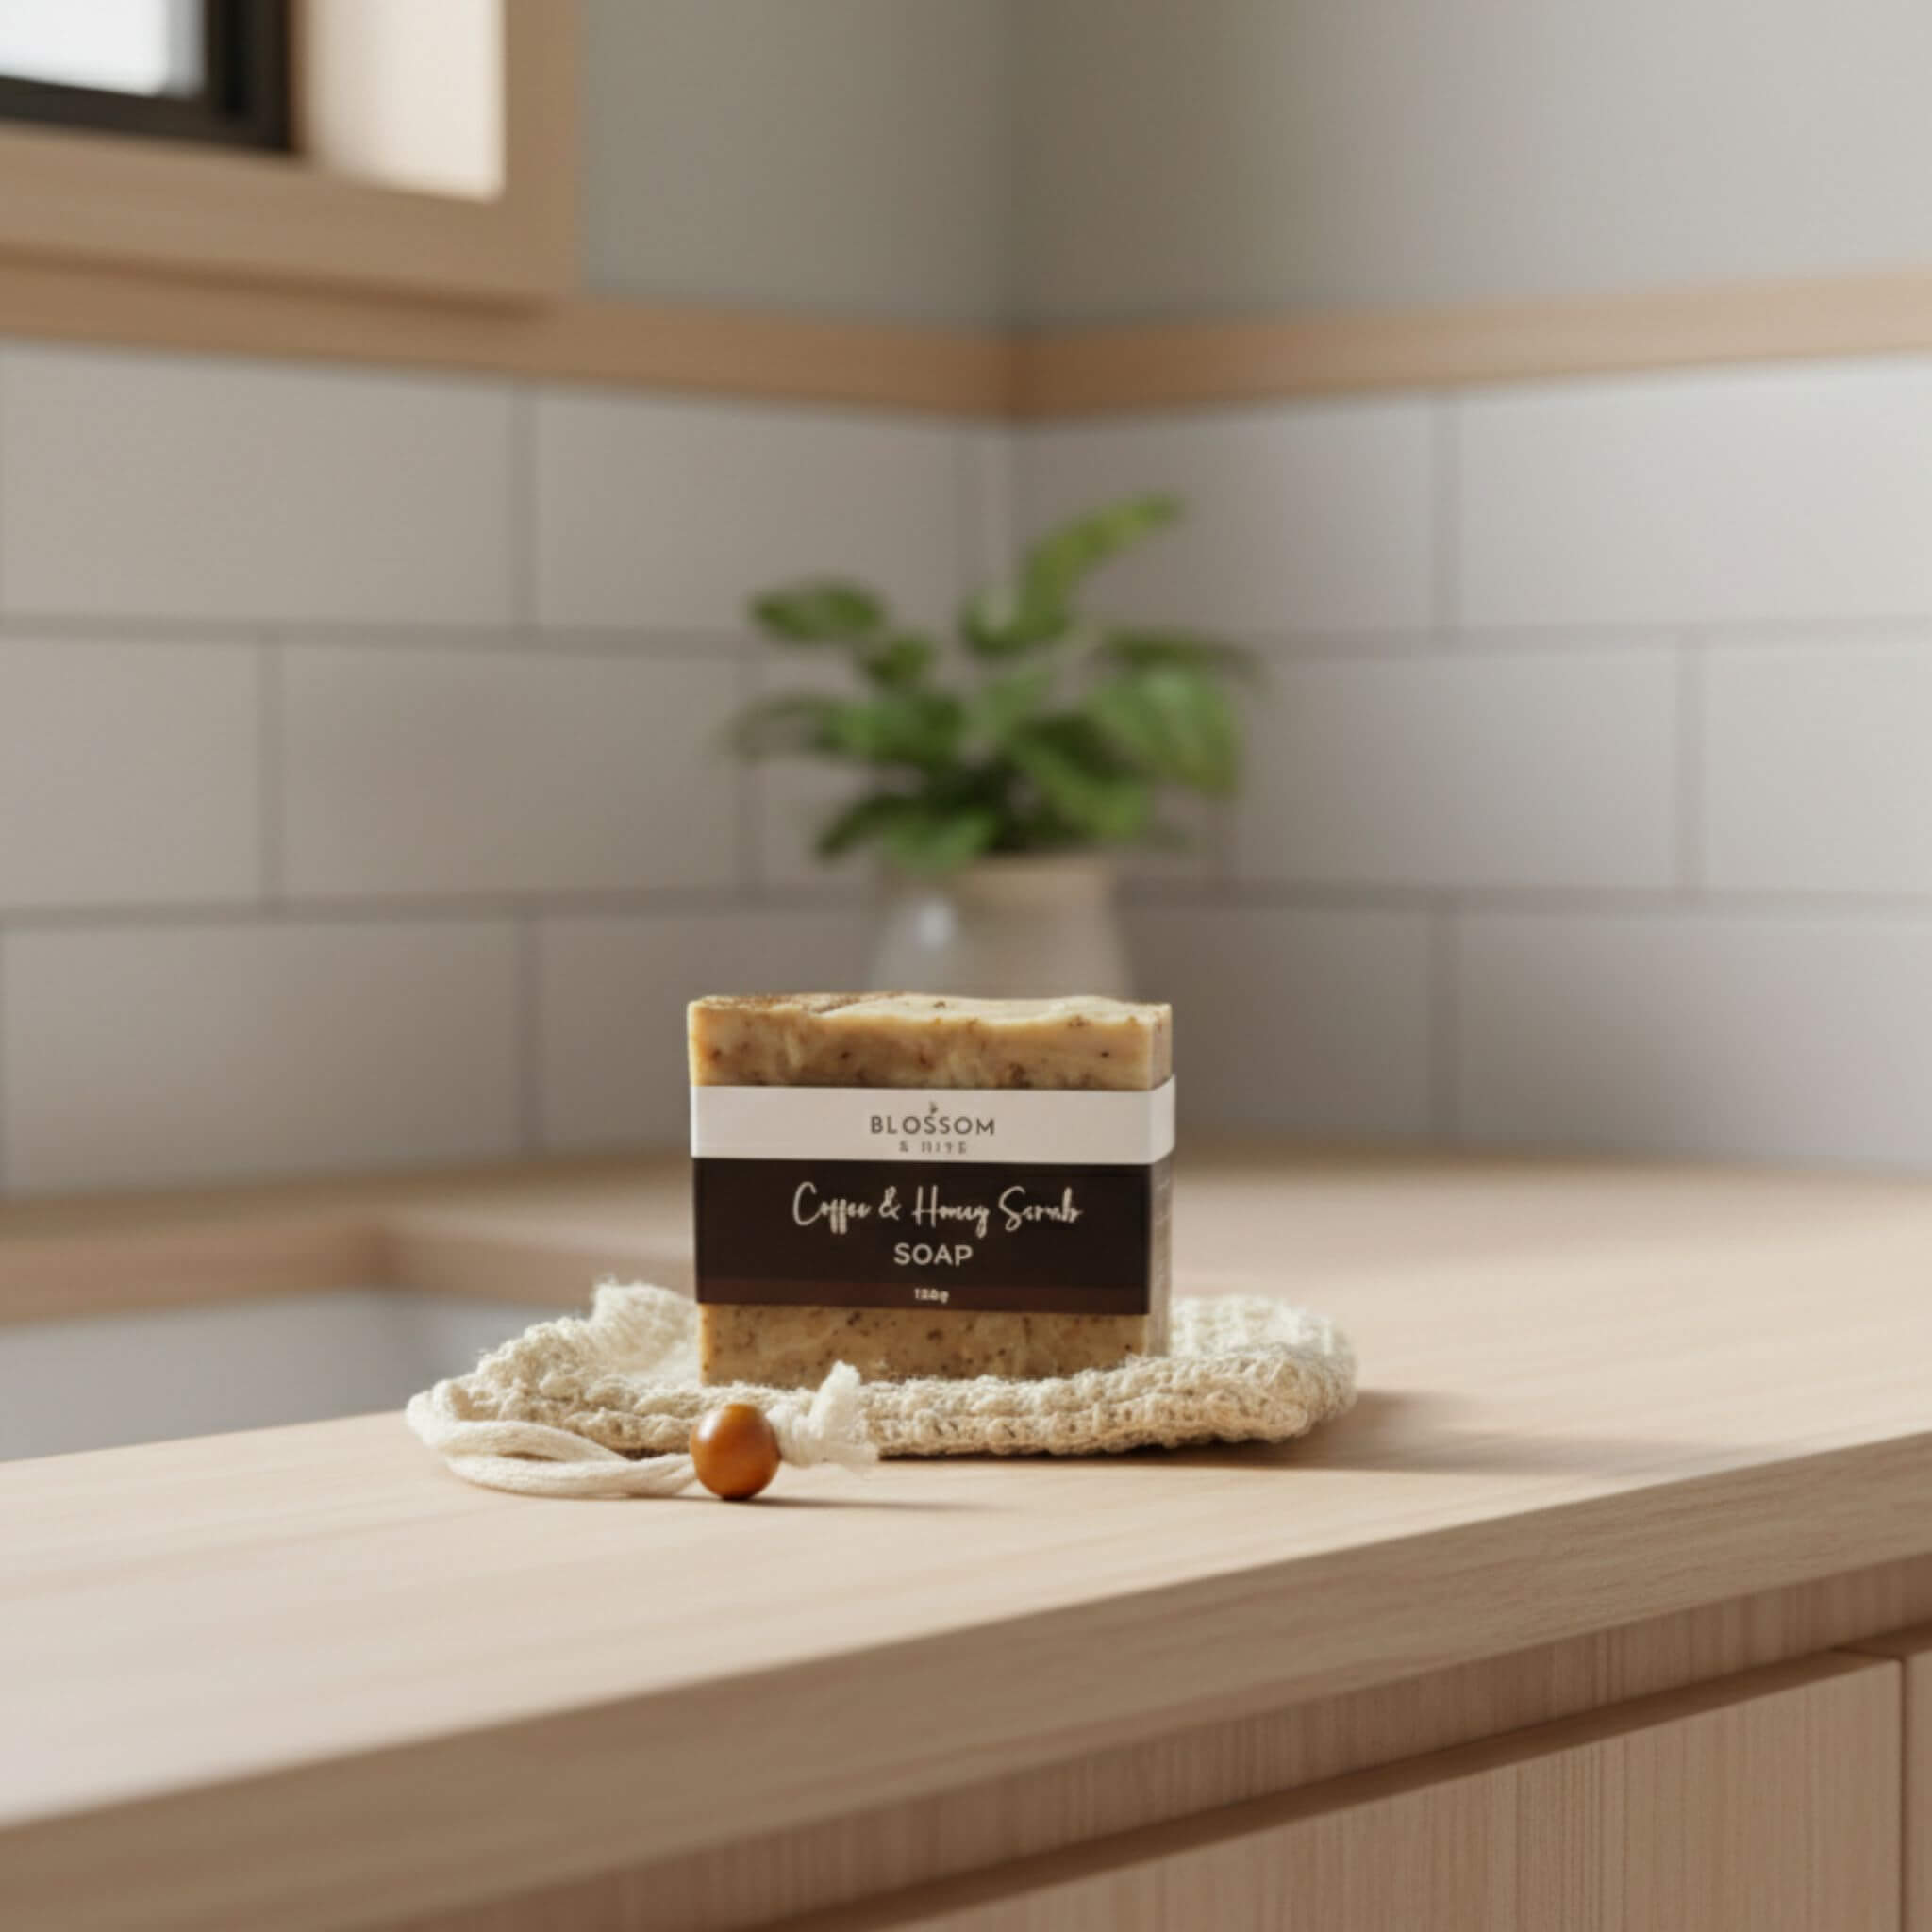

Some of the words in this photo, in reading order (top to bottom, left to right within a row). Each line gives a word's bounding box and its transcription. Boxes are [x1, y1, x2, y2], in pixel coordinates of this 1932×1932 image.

[870, 1116, 996, 1136] BLOSSOM
[792, 1181, 872, 1234] Coffee
[878, 1185, 902, 1221] &
[911, 1185, 991, 1239] Honey
[998, 1186, 1082, 1231] Scrub
[893, 1242, 974, 1267] SOAP
